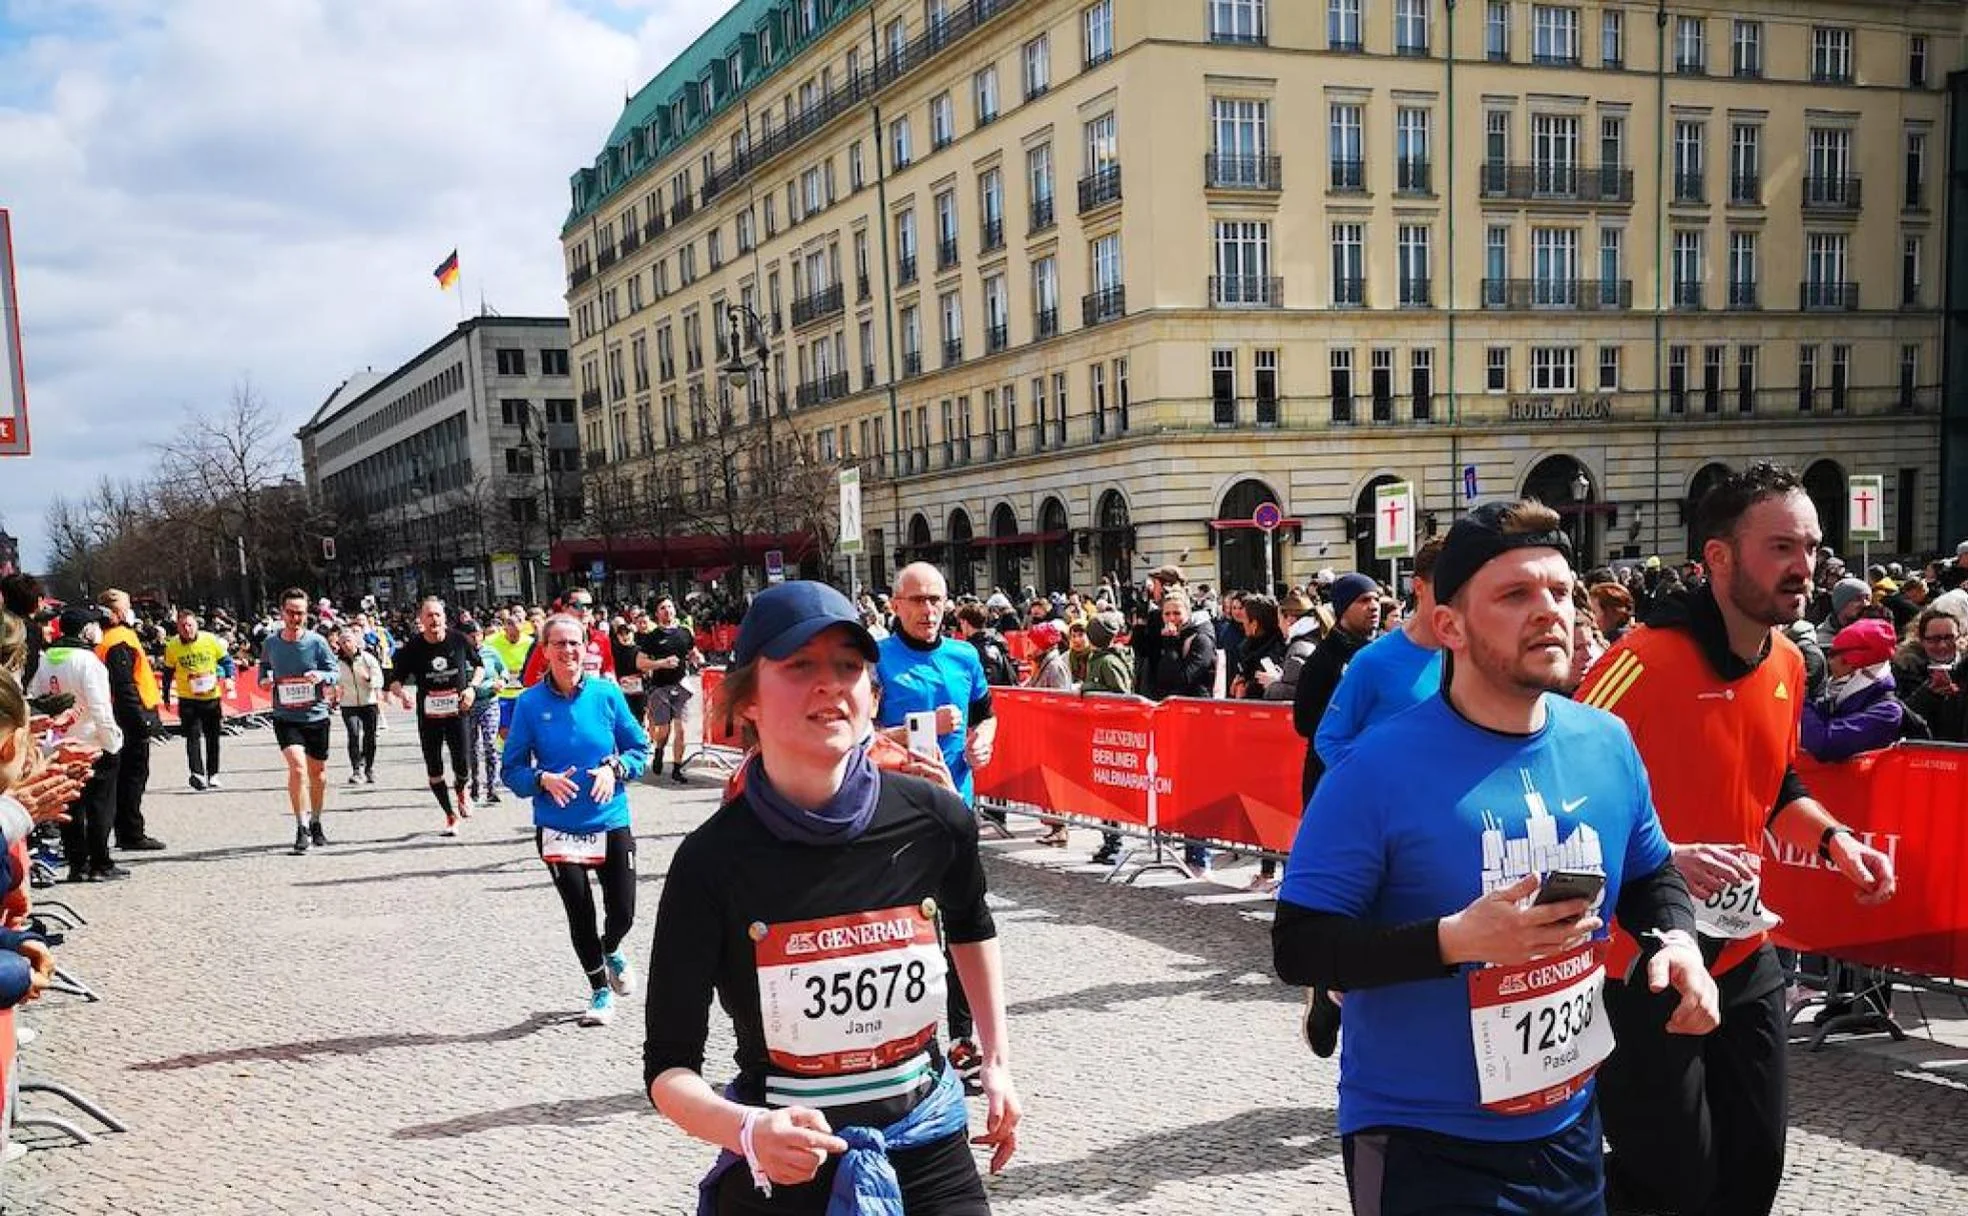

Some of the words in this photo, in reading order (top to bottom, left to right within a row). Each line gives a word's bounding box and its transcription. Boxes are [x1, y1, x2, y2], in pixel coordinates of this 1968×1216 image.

[1511, 400, 1559, 419] HOTEL
[1092, 748, 1139, 769] BERLINER
[816, 918, 915, 950] GENERALI
[789, 967, 800, 981] F
[803, 959, 926, 1020] 35678
[1501, 1005, 1512, 1019] E
[844, 1018, 883, 1036] Jana
